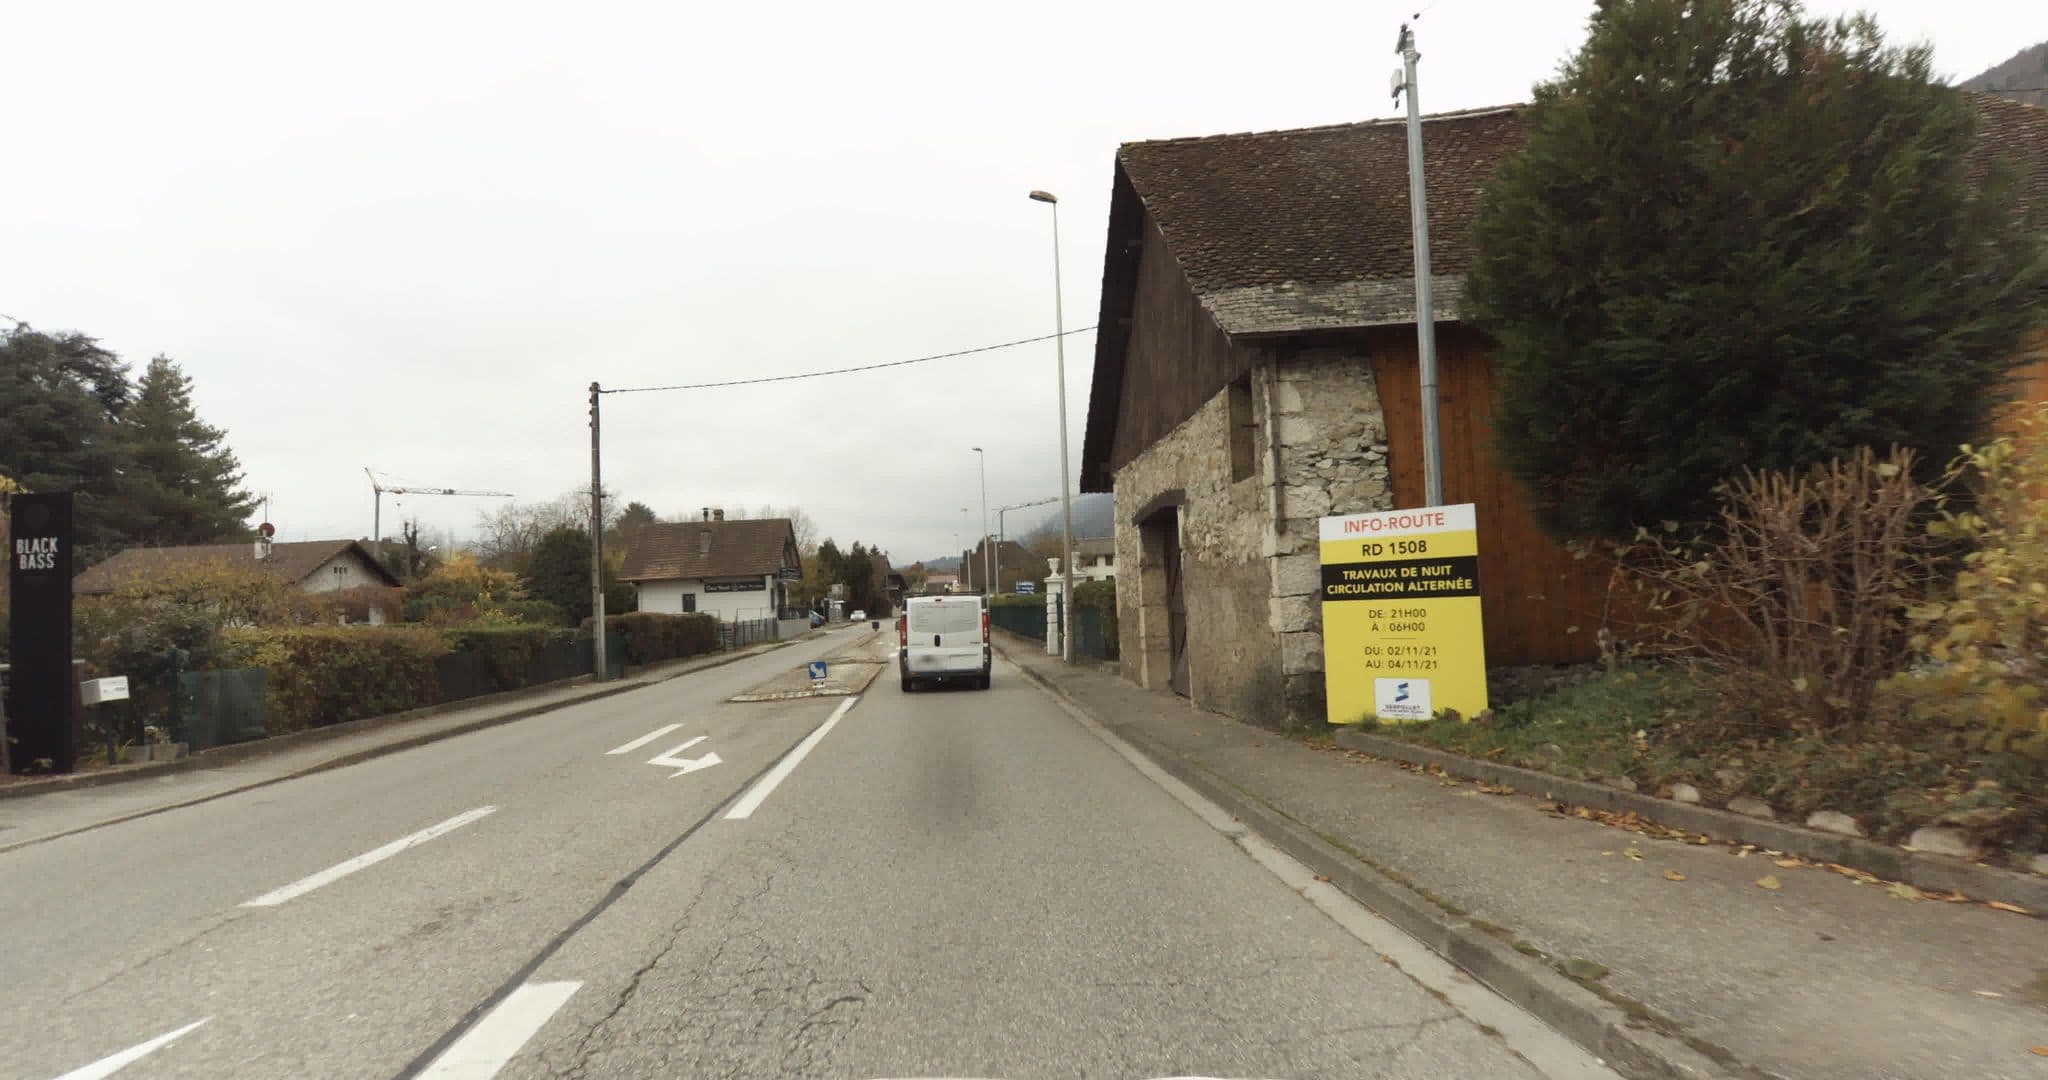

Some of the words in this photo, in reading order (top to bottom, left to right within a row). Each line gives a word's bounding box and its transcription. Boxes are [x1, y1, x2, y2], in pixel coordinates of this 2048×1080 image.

[1344, 512, 1445, 533] INFO-ROUTE
[16, 537, 58, 554] BLACK
[1362, 543, 1383, 557] RD
[1389, 540, 1428, 555] 1508
[19, 553, 55, 569] BASS
[1343, 568, 1397, 581] TRAVAUX
[1400, 567, 1419, 578] DE
[1421, 565, 1453, 577] NUIT
[1327, 582, 1405, 595] CIRCULATION
[1408, 577, 1473, 592] ALTERNÉE
[1391, 608, 1427, 619] 21H00
[1389, 622, 1425, 632] 06H00
[1365, 646, 1384, 656] DU:
[1387, 646, 1437, 656] 02/11/21
[1365, 660, 1385, 669] AU:
[1387, 660, 1438, 669] 04/11/21
